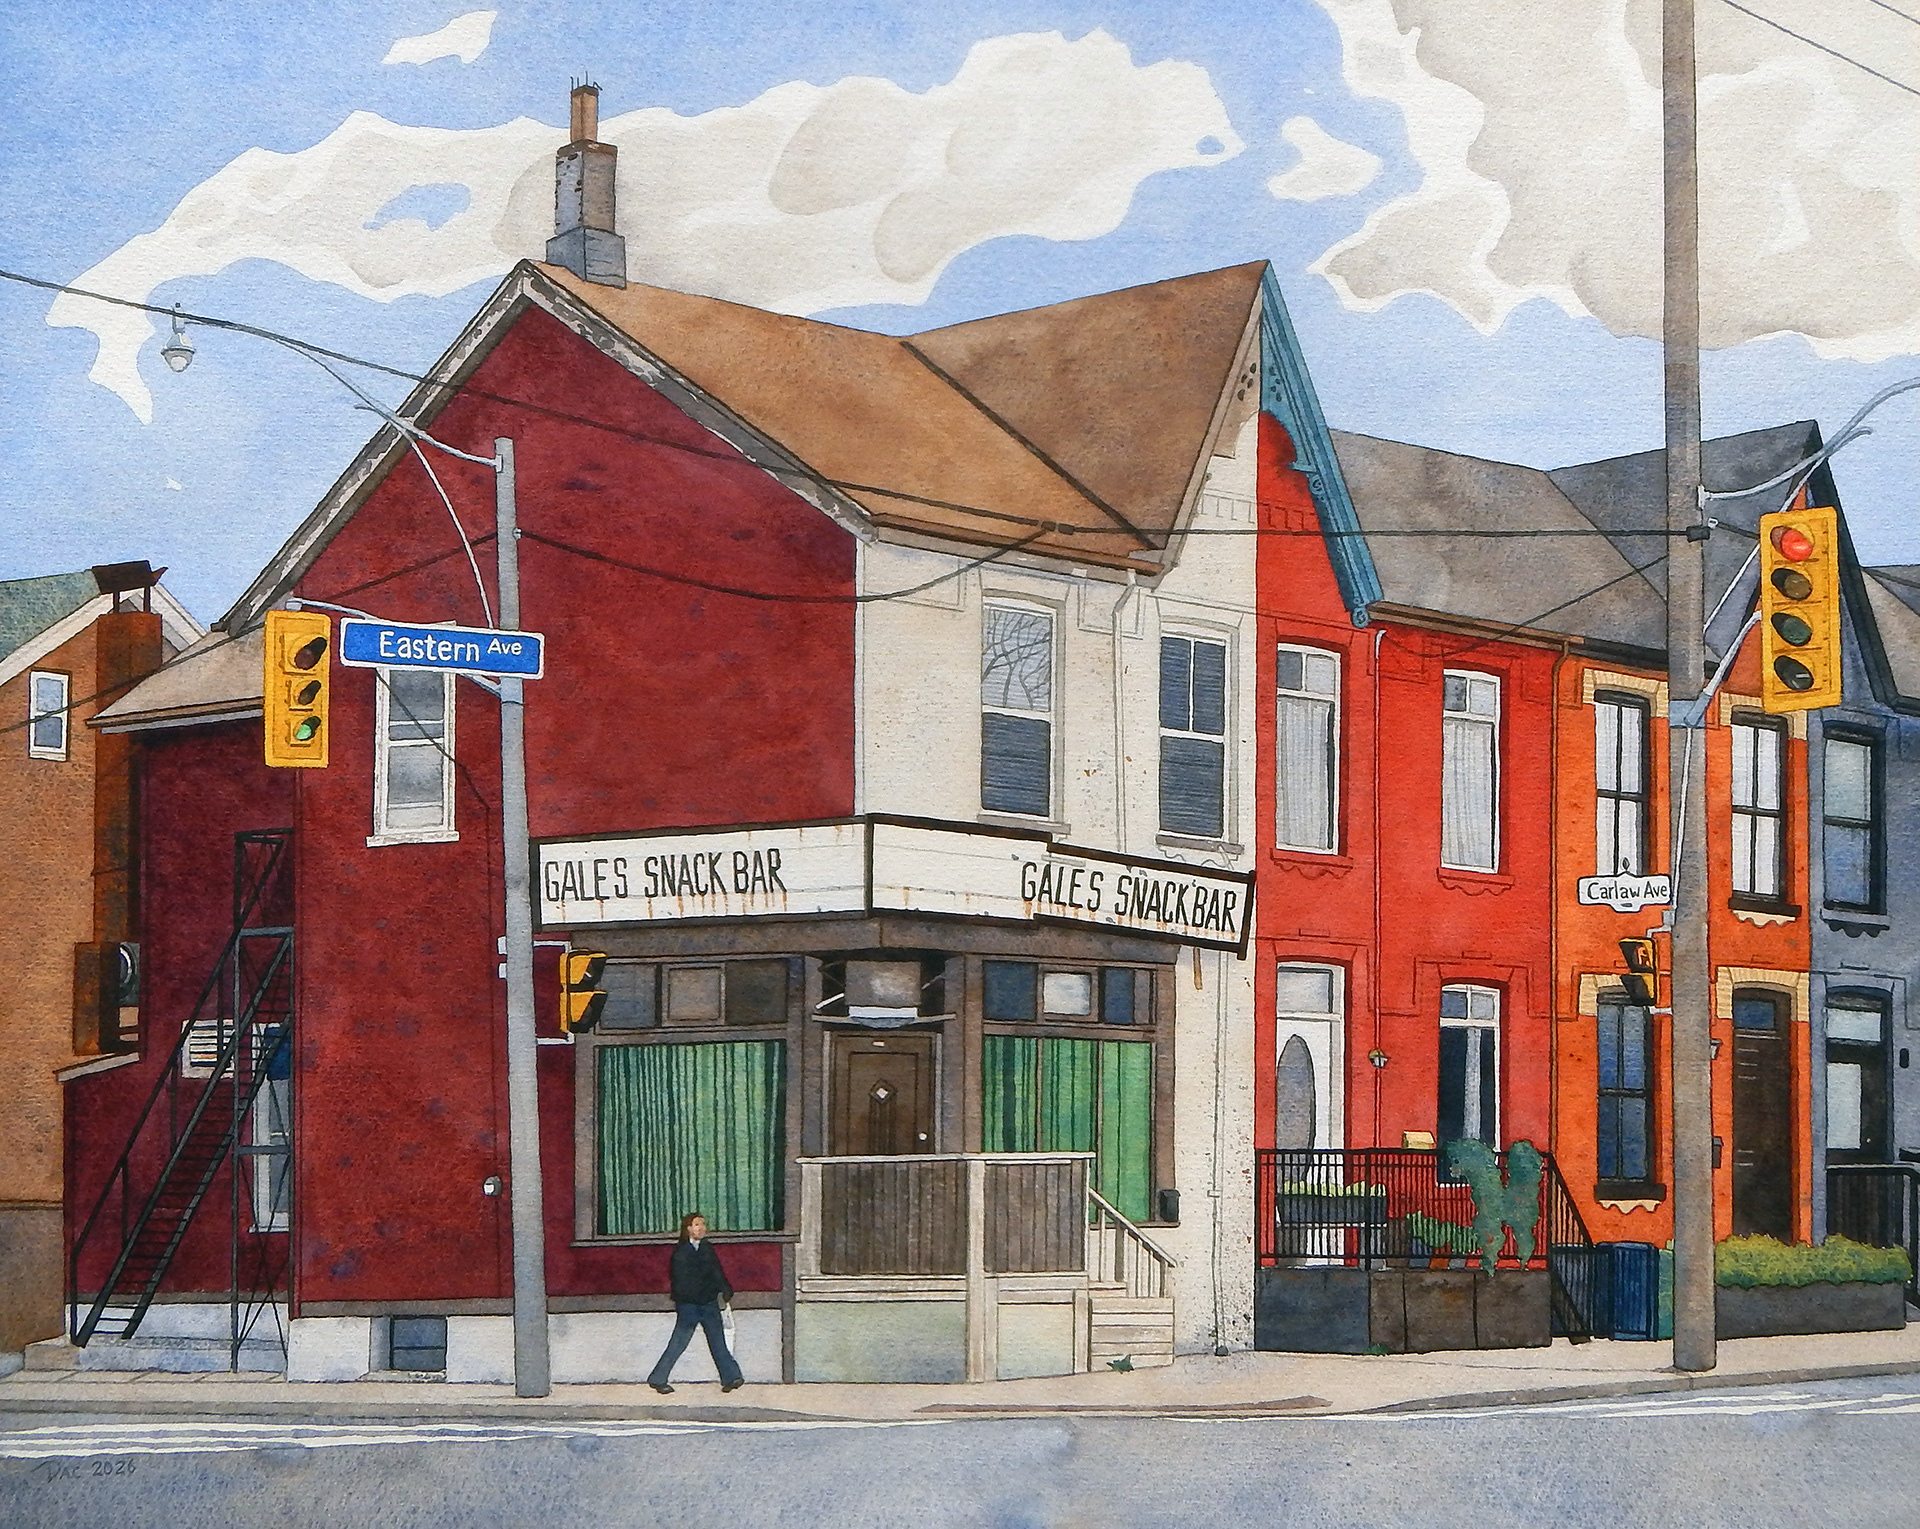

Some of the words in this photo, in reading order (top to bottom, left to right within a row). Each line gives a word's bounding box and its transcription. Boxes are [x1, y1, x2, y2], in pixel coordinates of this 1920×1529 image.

[379, 630, 480, 662] Eastern
[487, 637, 523, 655] Ave
[544, 857, 629, 902] GALES
[644, 852, 728, 898] SNACK
[733, 848, 788, 895] BAR
[1587, 880, 1641, 900] Carlaw
[1643, 880, 1668, 898] Ave
[1021, 861, 1104, 912] GALES
[1114, 874, 1191, 926] SNACK
[1191, 886, 1238, 933] BAR
[91, 1459, 137, 1477] 2026
